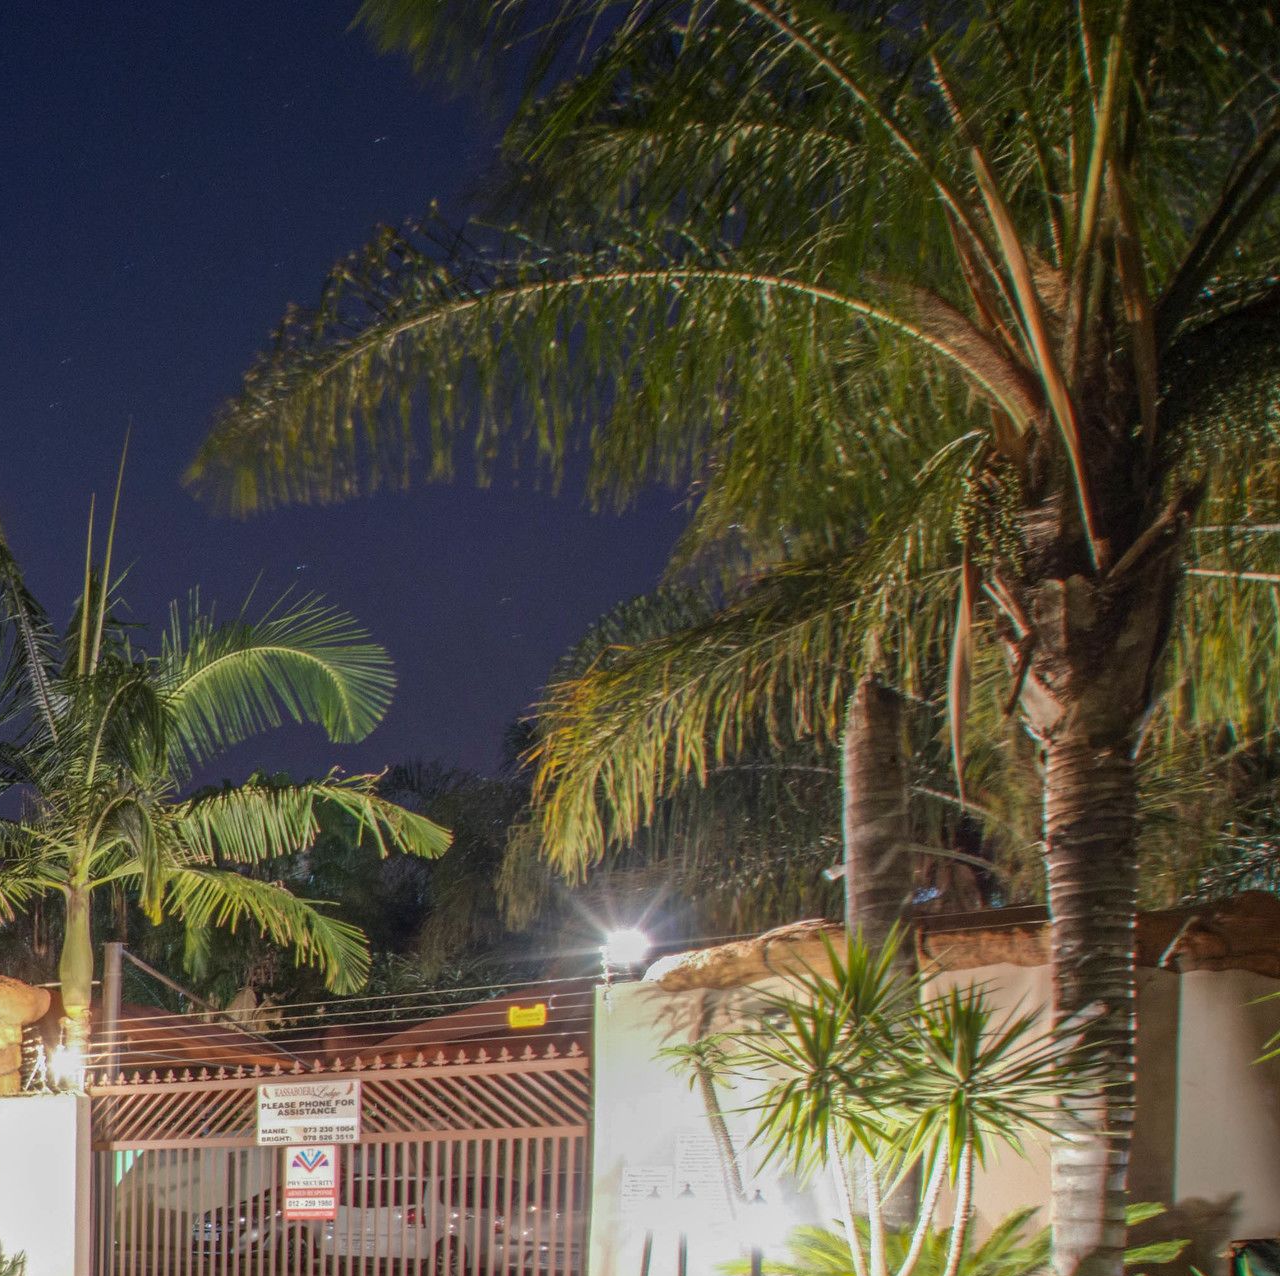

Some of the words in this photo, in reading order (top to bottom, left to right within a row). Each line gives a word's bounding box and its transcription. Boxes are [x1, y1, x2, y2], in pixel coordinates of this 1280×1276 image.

[274, 1086, 316, 1098] KASSABOERA
[314, 1085, 342, 1099] Lodge
[261, 1101, 296, 1109] PLEASE
[299, 1100, 332, 1108] PHONE
[335, 1099, 355, 1107] FOR
[277, 1107, 337, 1116] ASSISTANCE
